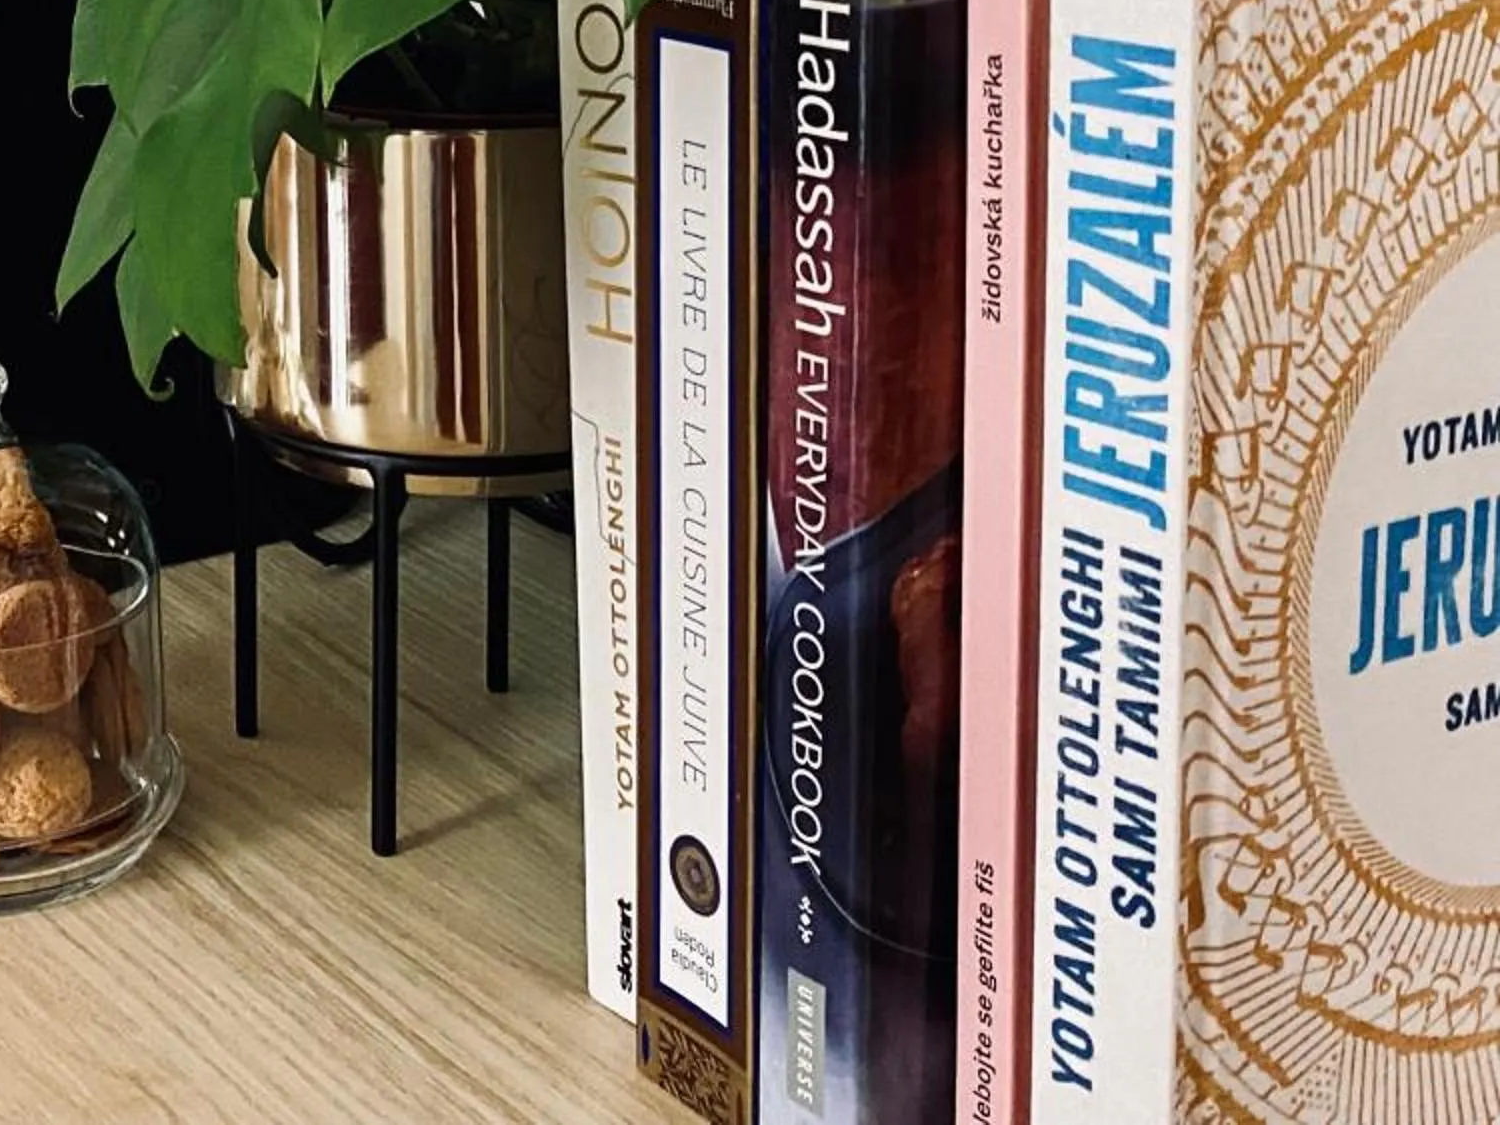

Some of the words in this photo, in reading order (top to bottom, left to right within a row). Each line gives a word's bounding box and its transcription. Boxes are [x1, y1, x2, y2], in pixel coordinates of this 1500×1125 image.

[682, 139, 707, 191] LE
[982, 53, 1002, 189] kuchařka
[682, 207, 707, 332] LIVRE
[981, 197, 1002, 323] židovská
[1051, 34, 1177, 533] JERUZALÉM
[682, 346, 707, 407] DE
[682, 421, 707, 468] LA
[794, 349, 829, 594] EVERYDAY
[604, 436, 630, 678] OTTOLENGHI
[682, 487, 707, 657] CUISINE
[1053, 527, 1105, 890] OTTOLENGHI
[1113, 546, 1164, 760] TAMIMI
[615, 690, 635, 812] YOTAM
[682, 665, 707, 793] JUIVE
[790, 602, 825, 876] COOKBOOK
[974, 859, 995, 896] fiš
[1110, 782, 1157, 930] SAMI
[616, 897, 634, 993] slovart
[972, 901, 997, 993] gefilte
[1051, 897, 1097, 1094] YOTAM
[798, 983, 814, 1104] UNIVERSE
[978, 995, 994, 1028] se
